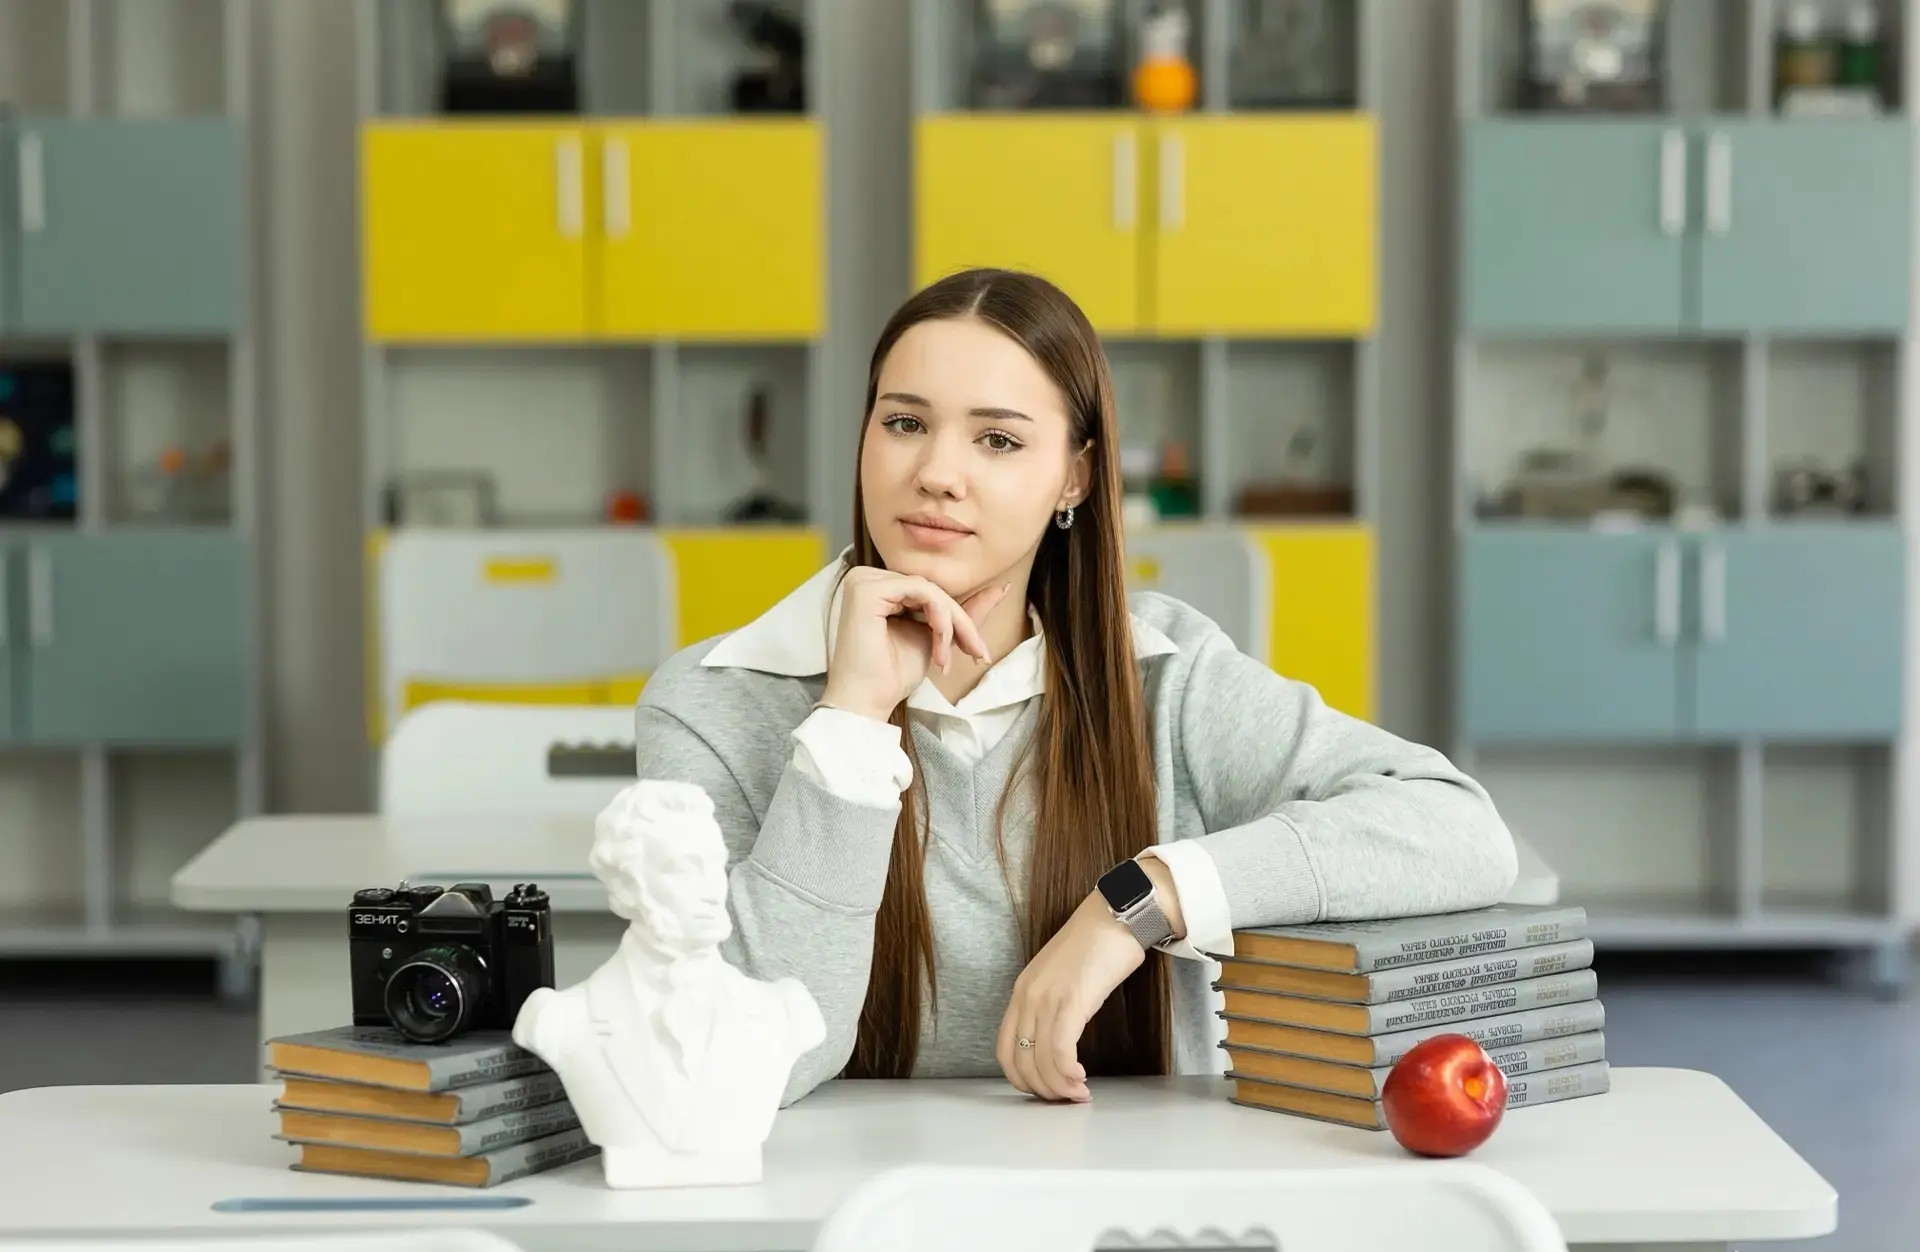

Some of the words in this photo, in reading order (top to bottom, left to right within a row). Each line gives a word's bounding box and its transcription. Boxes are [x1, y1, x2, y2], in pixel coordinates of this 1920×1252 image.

[355, 914, 399, 924] ЗЕНИТ
[1429, 934, 1469, 950] РУССКОГО
[1472, 929, 1507, 943] СЛОВАРЬ
[1400, 940, 1428, 952] ЯЗЫКА
[1459, 939, 1507, 956] ШКОЛЬНЫЙ
[1442, 964, 1481, 980] РУССКОГО
[1483, 959, 1518, 973] СЛОВАРЬ
[1413, 971, 1440, 985] ЯЗЫКА
[1470, 969, 1517, 986] ШКОЛЬНЫЙ
[1440, 991, 1479, 1007] РУССКОГО
[1481, 987, 1517, 1002] СЛОВАРЬ
[1410, 1000, 1438, 1012] ЯЗЫКА
[1470, 998, 1517, 1015] ШКОЛЬНЫЙ
[1488, 1023, 1523, 1038] СЛОВАРЬ
